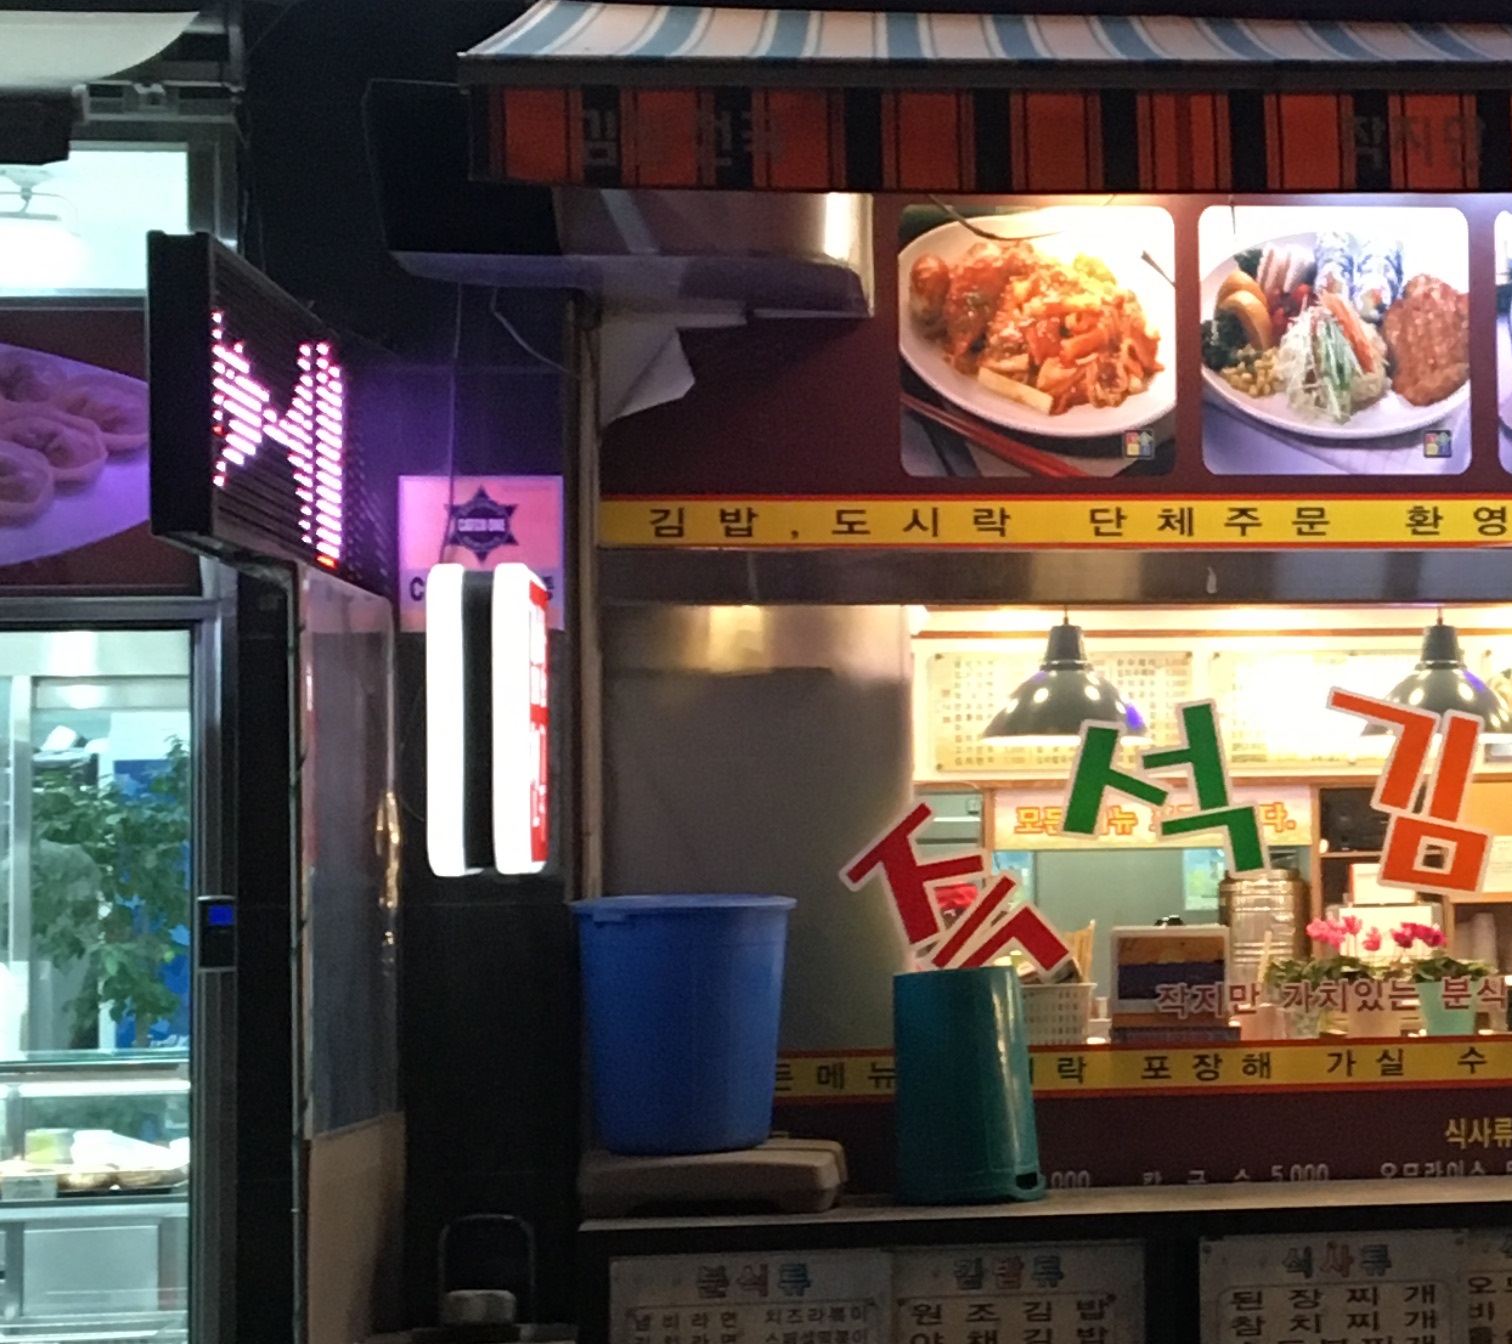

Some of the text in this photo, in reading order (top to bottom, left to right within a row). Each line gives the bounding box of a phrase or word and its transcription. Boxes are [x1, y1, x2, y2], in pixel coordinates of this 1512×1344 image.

[1088, 506, 1331, 537] 단체주문
[1156, 975, 1509, 1020] 작지만 가치있는 분식
[1141, 1052, 1273, 1082] 포장해
[1327, 1049, 1406, 1078] 가실
[1457, 1045, 1488, 1074] 수
[1282, 1242, 1392, 1279] 식사류
[910, 1298, 1108, 1326] 원조김밥
[1231, 1284, 1436, 1311] 된장찌개
[1231, 1309, 1437, 1337] 참치찌개
